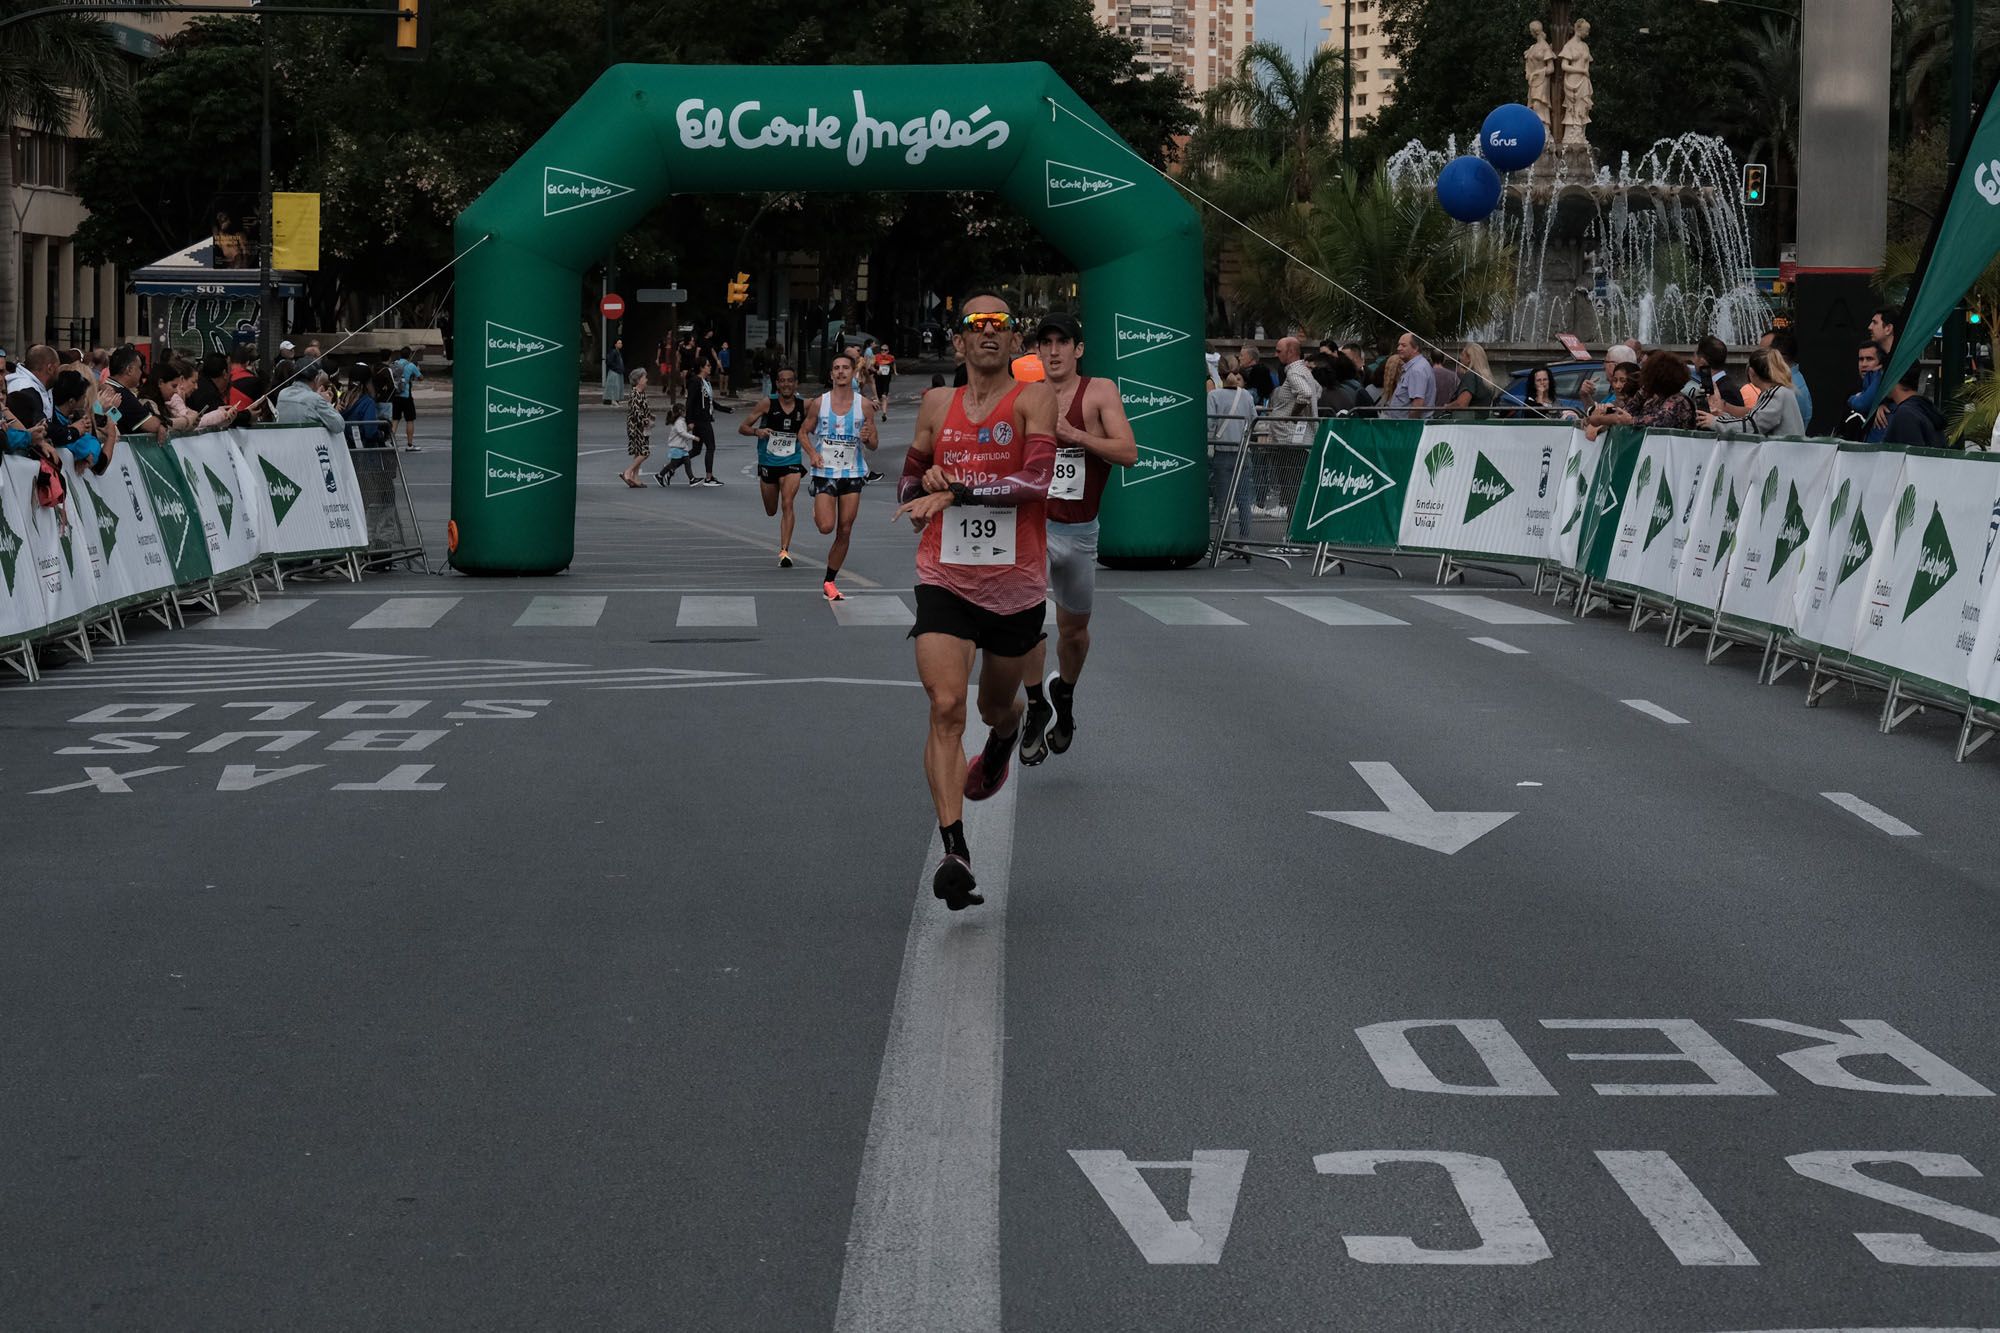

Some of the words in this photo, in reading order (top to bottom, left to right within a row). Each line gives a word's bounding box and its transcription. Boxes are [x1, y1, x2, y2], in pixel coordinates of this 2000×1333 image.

[675, 98, 727, 150] El
[729, 100, 842, 150] Corte
[846, 89, 1011, 167] Inglés
[547, 183, 557, 195] El
[557, 183, 580, 195] Corte
[579, 181, 612, 199] Inglés
[1050, 178, 1060, 189] El
[1060, 178, 1082, 189] Corte
[1081, 175, 1113, 192] Inglés
[1974, 159, 2000, 206] E
[196, 285, 226, 294] SUR
[1118, 329, 1127, 340] El
[1126, 330, 1146, 340] Corte
[1146, 328, 1174, 343] Inglés
[488, 337, 497, 349] El
[496, 338, 517, 349] Corte
[516, 337, 545, 353] Inglés
[1121, 393, 1130, 404] El
[1129, 394, 1150, 404] Corte
[1149, 391, 1177, 407] Inglés
[488, 402, 497, 413] El
[496, 403, 517, 414] Corte
[516, 402, 545, 418] Inglés
[772, 439, 792, 447] 6788
[834, 450, 845, 458] 24
[972, 451, 1010, 461] FERTILIDAD
[1152, 455, 1179, 470] Inglés
[488, 467, 497, 478] El
[496, 467, 517, 478] Corte
[516, 467, 545, 483] Inglés
[1052, 464, 1076, 479] 89
[1342, 465, 1374, 496] Inglés
[960, 519, 996, 538] 139
[66, 700, 553, 723] SOLO
[53, 730, 451, 755] BUS
[1353, 1018, 1998, 1097] RED
[1066, 1149, 2000, 1267] SICA
